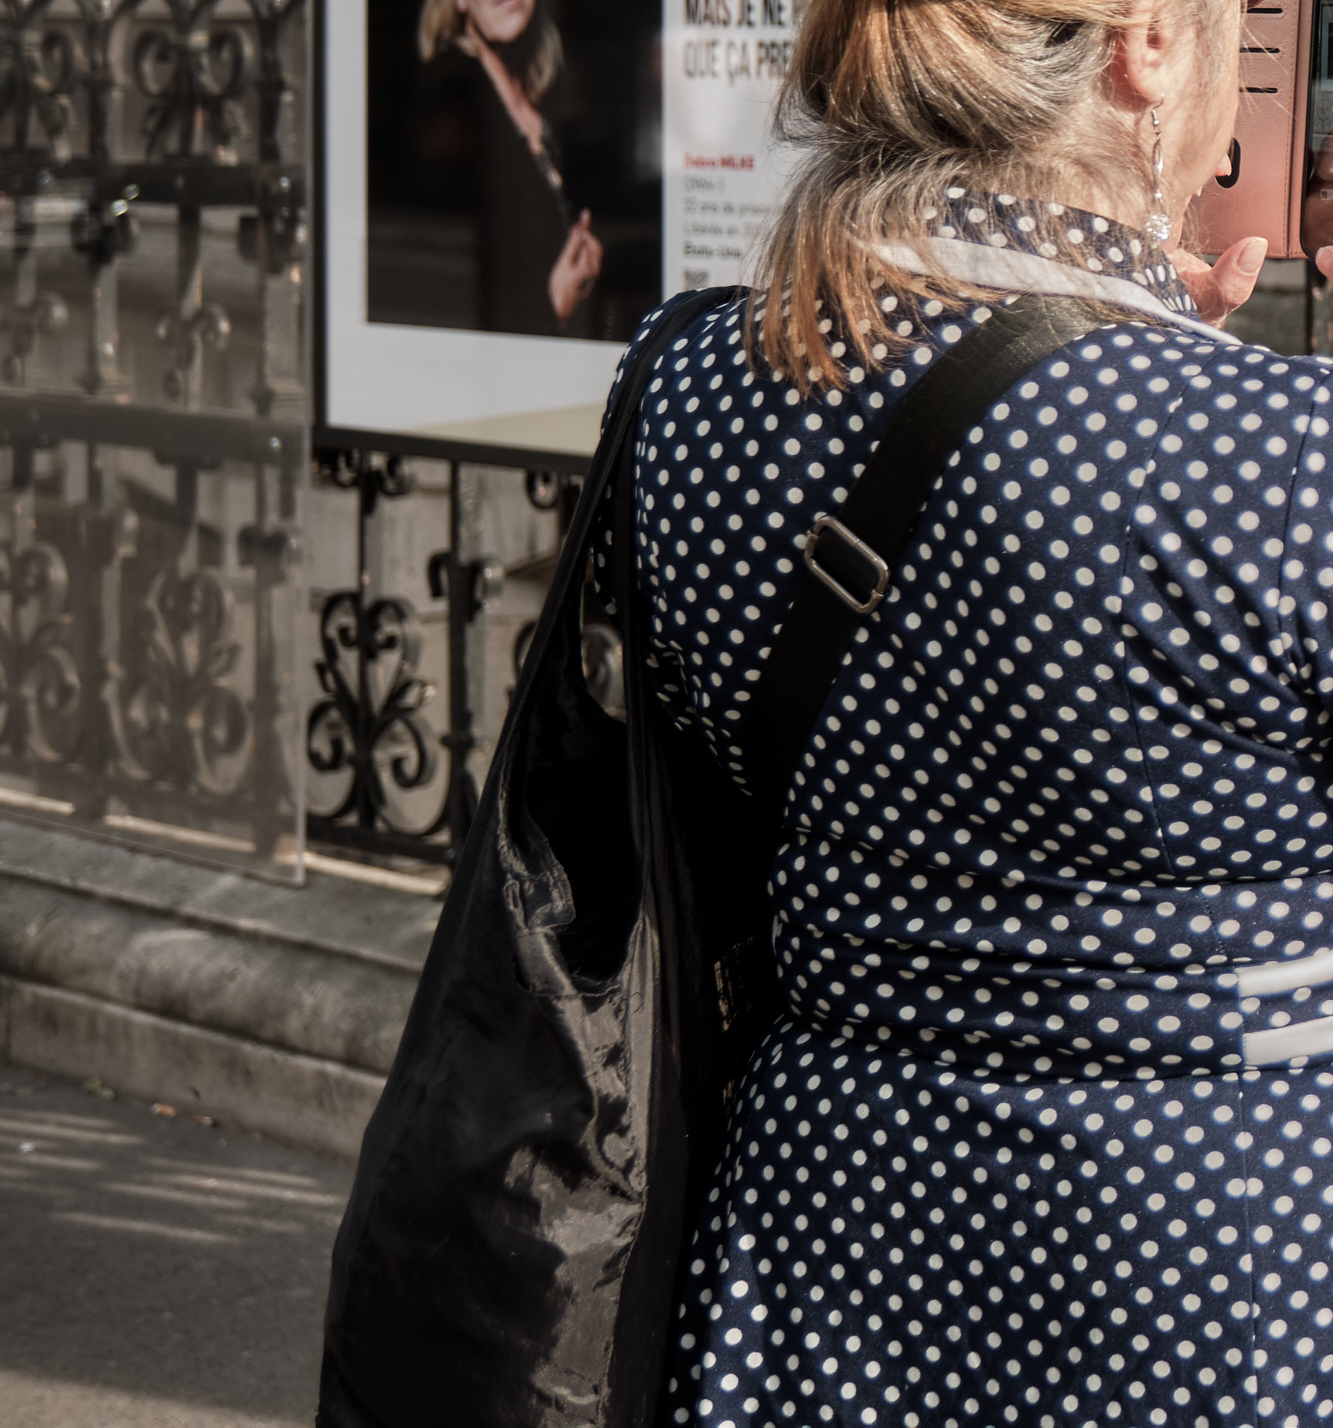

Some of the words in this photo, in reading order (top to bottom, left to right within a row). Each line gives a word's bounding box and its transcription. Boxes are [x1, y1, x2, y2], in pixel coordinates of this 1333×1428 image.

[684, 40, 719, 79] QUE
[727, 40, 751, 86] ÇA
[756, 40, 794, 79] PRE
